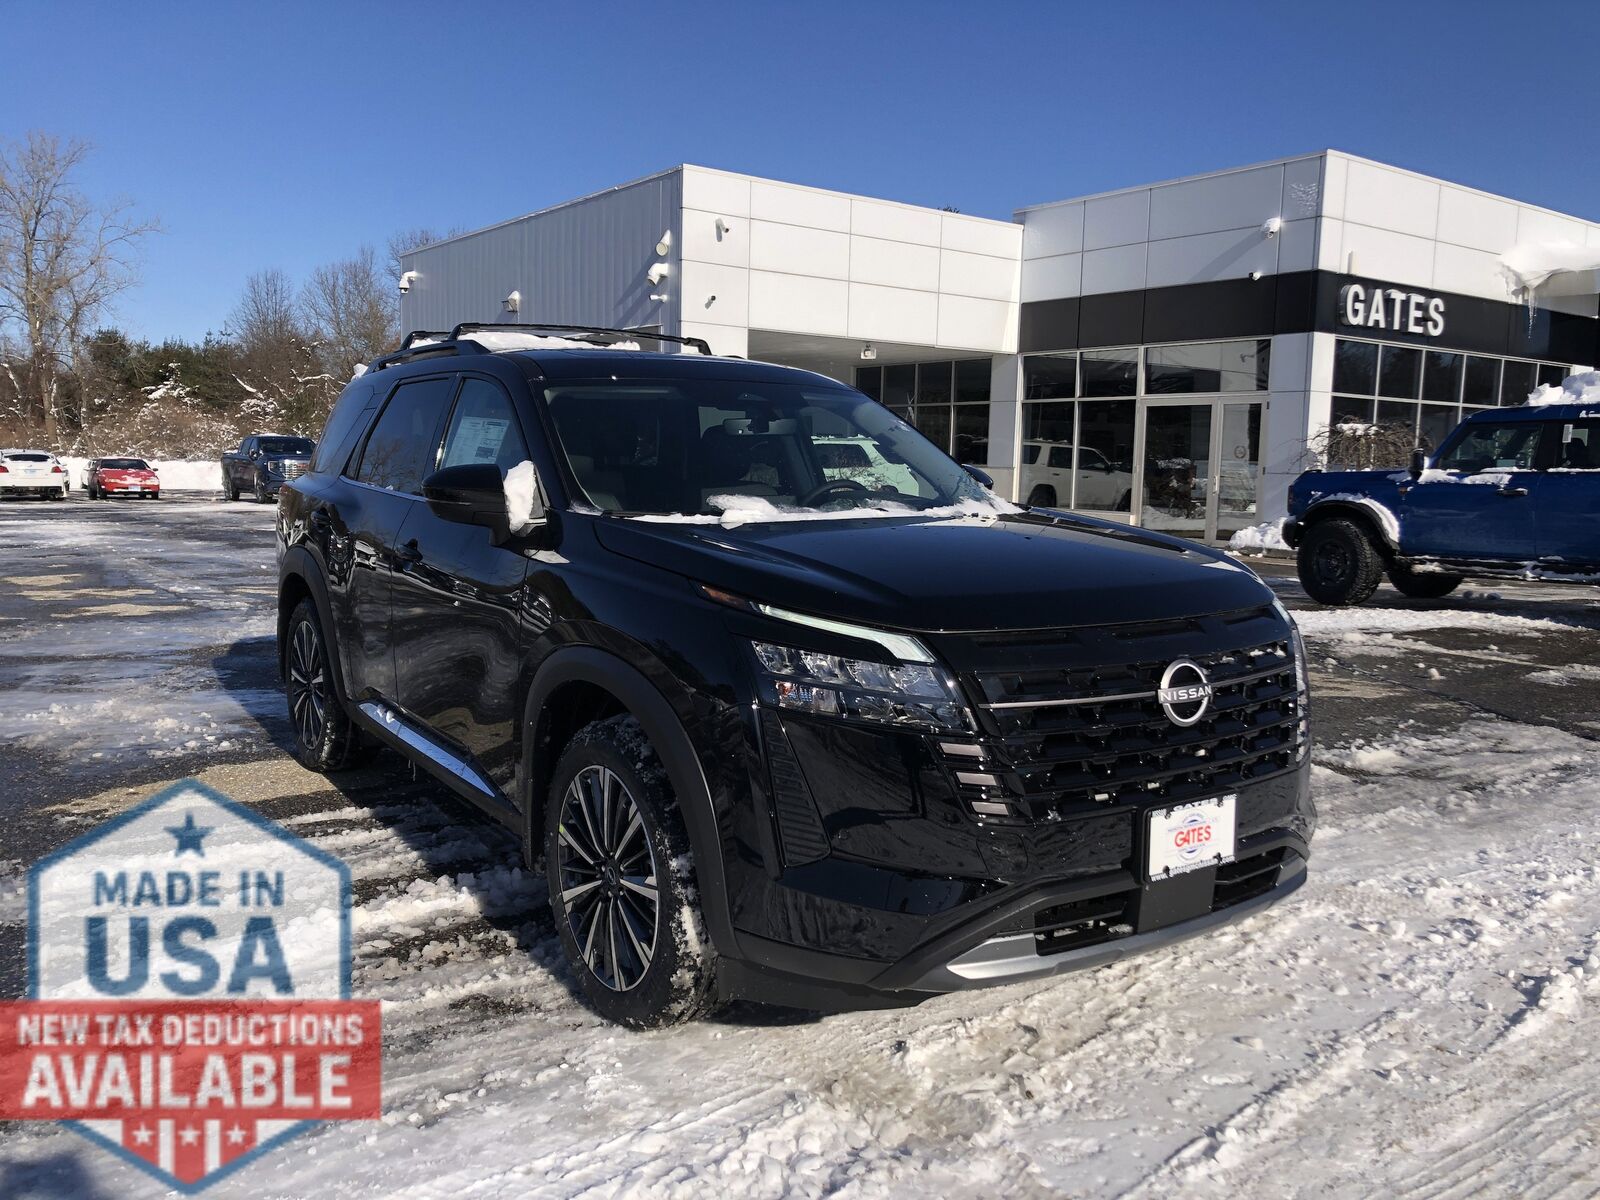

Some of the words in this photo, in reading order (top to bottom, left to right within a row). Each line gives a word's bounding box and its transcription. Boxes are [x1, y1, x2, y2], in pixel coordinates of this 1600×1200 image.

[1344, 284, 1445, 336] GATES
[1160, 684, 1211, 702] NISSAN
[1174, 825, 1211, 848] GATES
